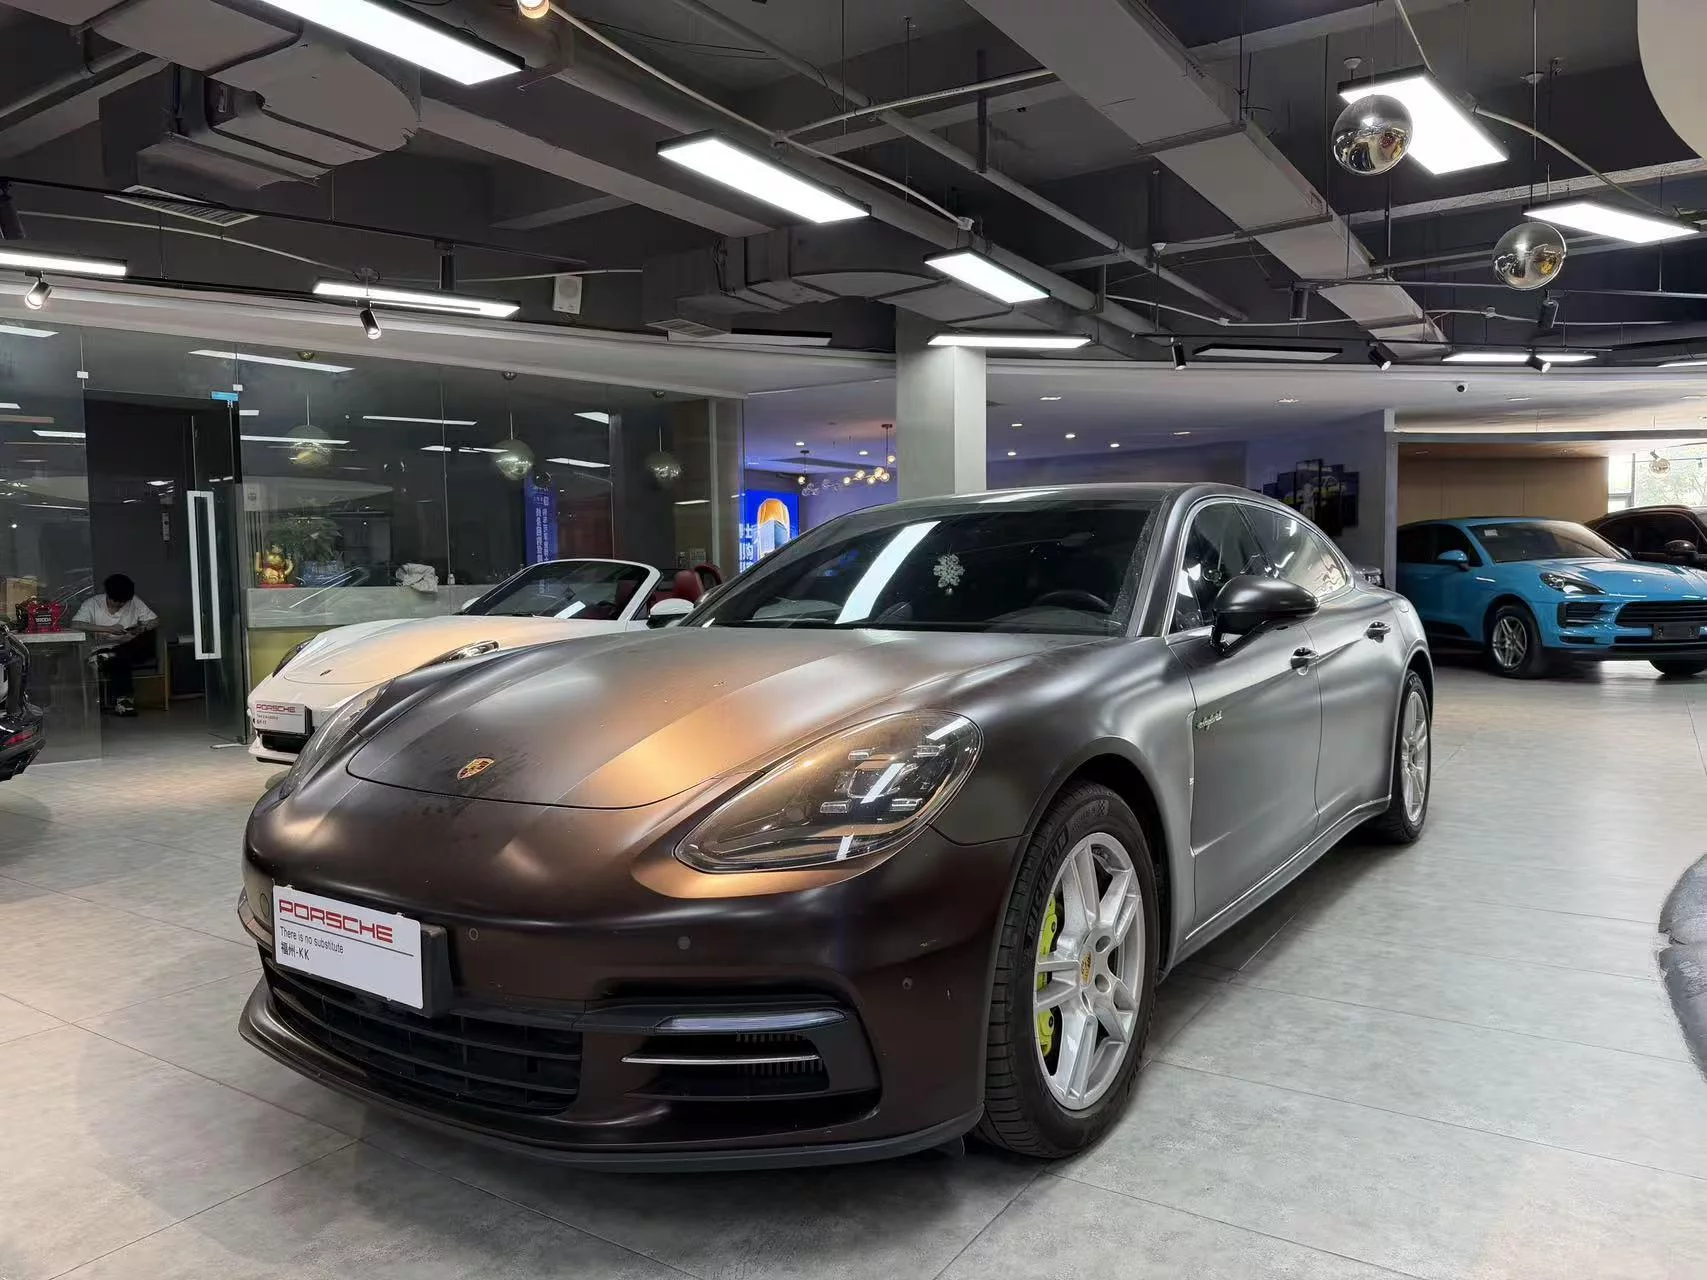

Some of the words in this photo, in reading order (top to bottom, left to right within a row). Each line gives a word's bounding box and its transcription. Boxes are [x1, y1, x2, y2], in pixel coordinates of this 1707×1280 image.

[256, 703, 296, 713] PORSCHE
[279, 899, 393, 944] PORSCHE
[280, 926, 297, 940] There
[298, 931, 304, 943] is
[305, 935, 313, 945] no
[314, 938, 344, 954] substitute
[281, 941, 310, 961] 福州-KK
